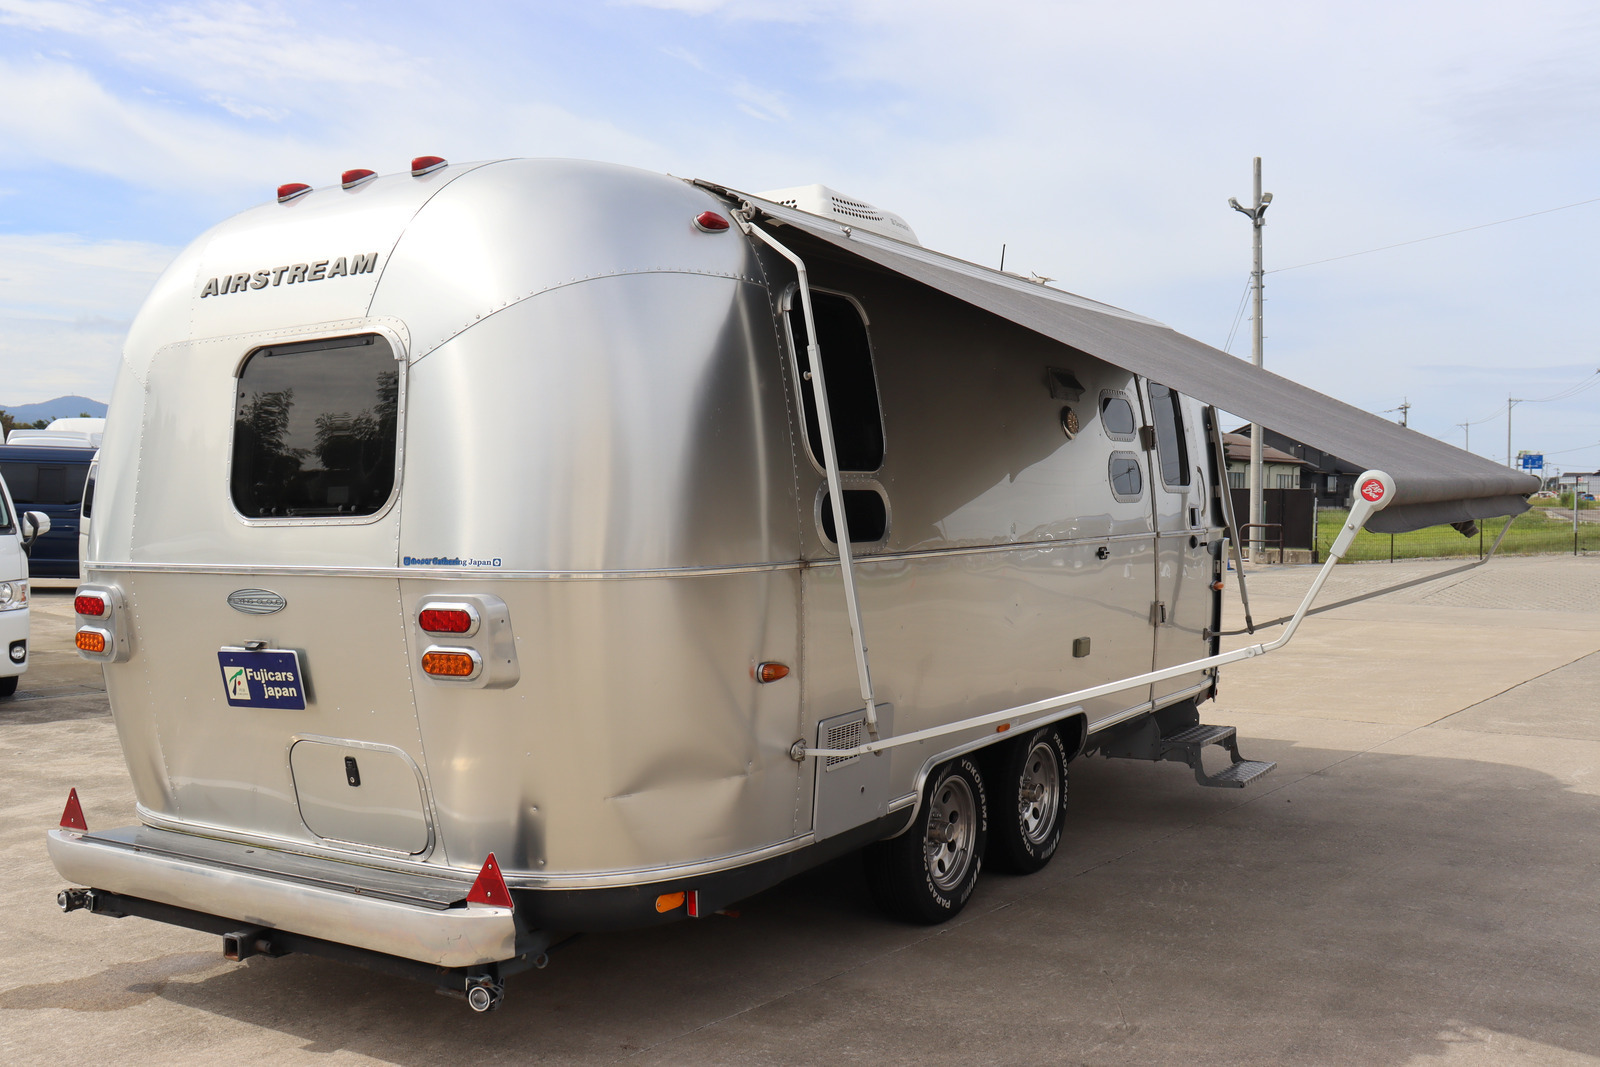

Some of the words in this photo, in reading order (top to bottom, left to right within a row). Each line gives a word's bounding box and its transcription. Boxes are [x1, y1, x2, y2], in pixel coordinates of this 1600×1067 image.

[200, 252, 378, 299] AIRSTREAM
[468, 558, 492, 567] Japan
[246, 668, 295, 684] Fujicars
[263, 684, 298, 699] japan
[1053, 733, 1069, 776] PARADA
[961, 759, 987, 832] YOKOHAMA
[925, 872, 951, 909] PARADA
